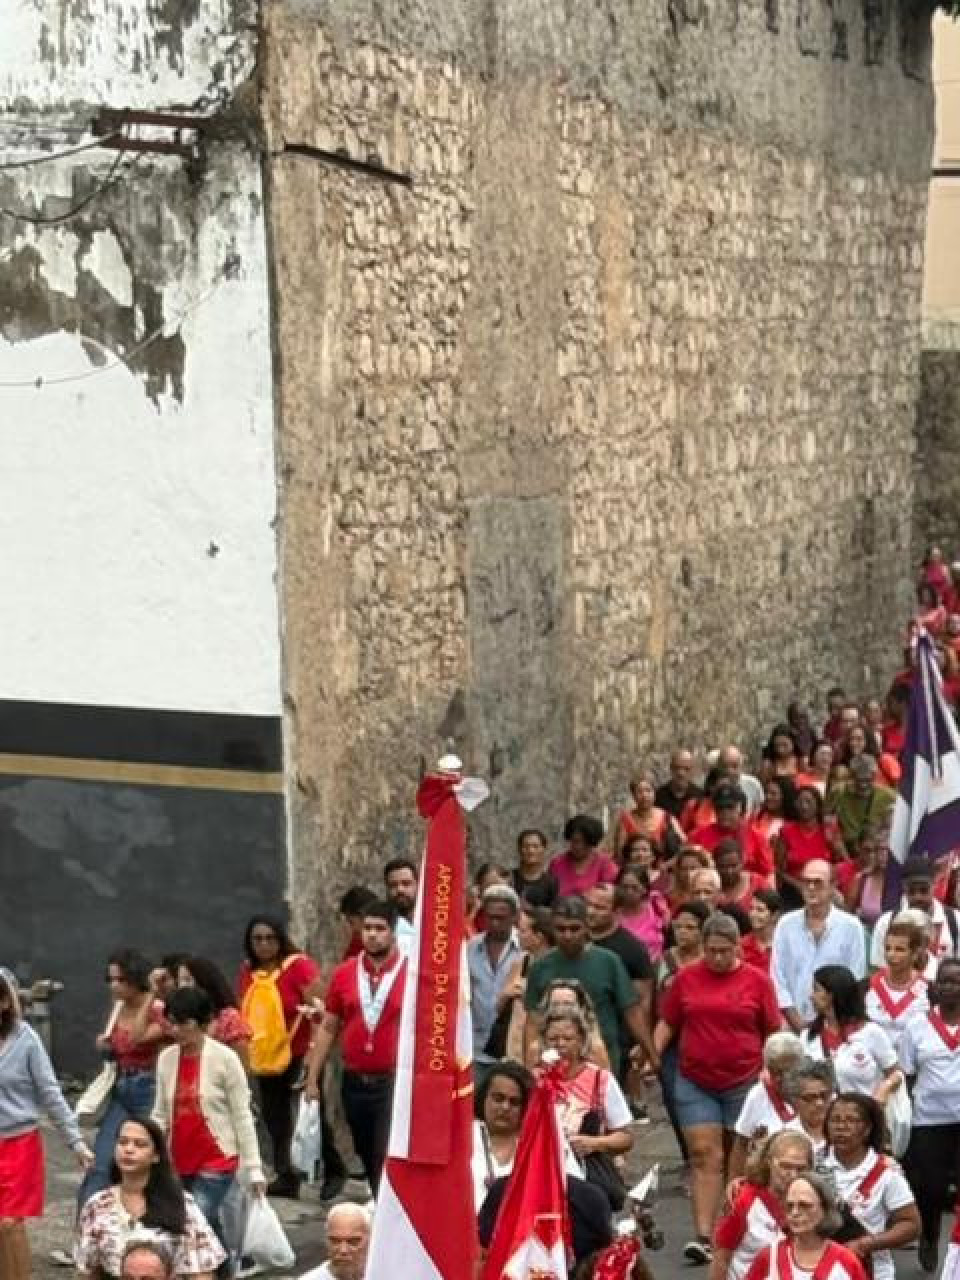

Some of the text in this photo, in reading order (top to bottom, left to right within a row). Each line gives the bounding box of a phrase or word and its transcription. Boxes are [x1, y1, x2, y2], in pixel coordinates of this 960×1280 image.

[428, 863, 453, 1071] APOSTOLADO DA ORAÇÃO
